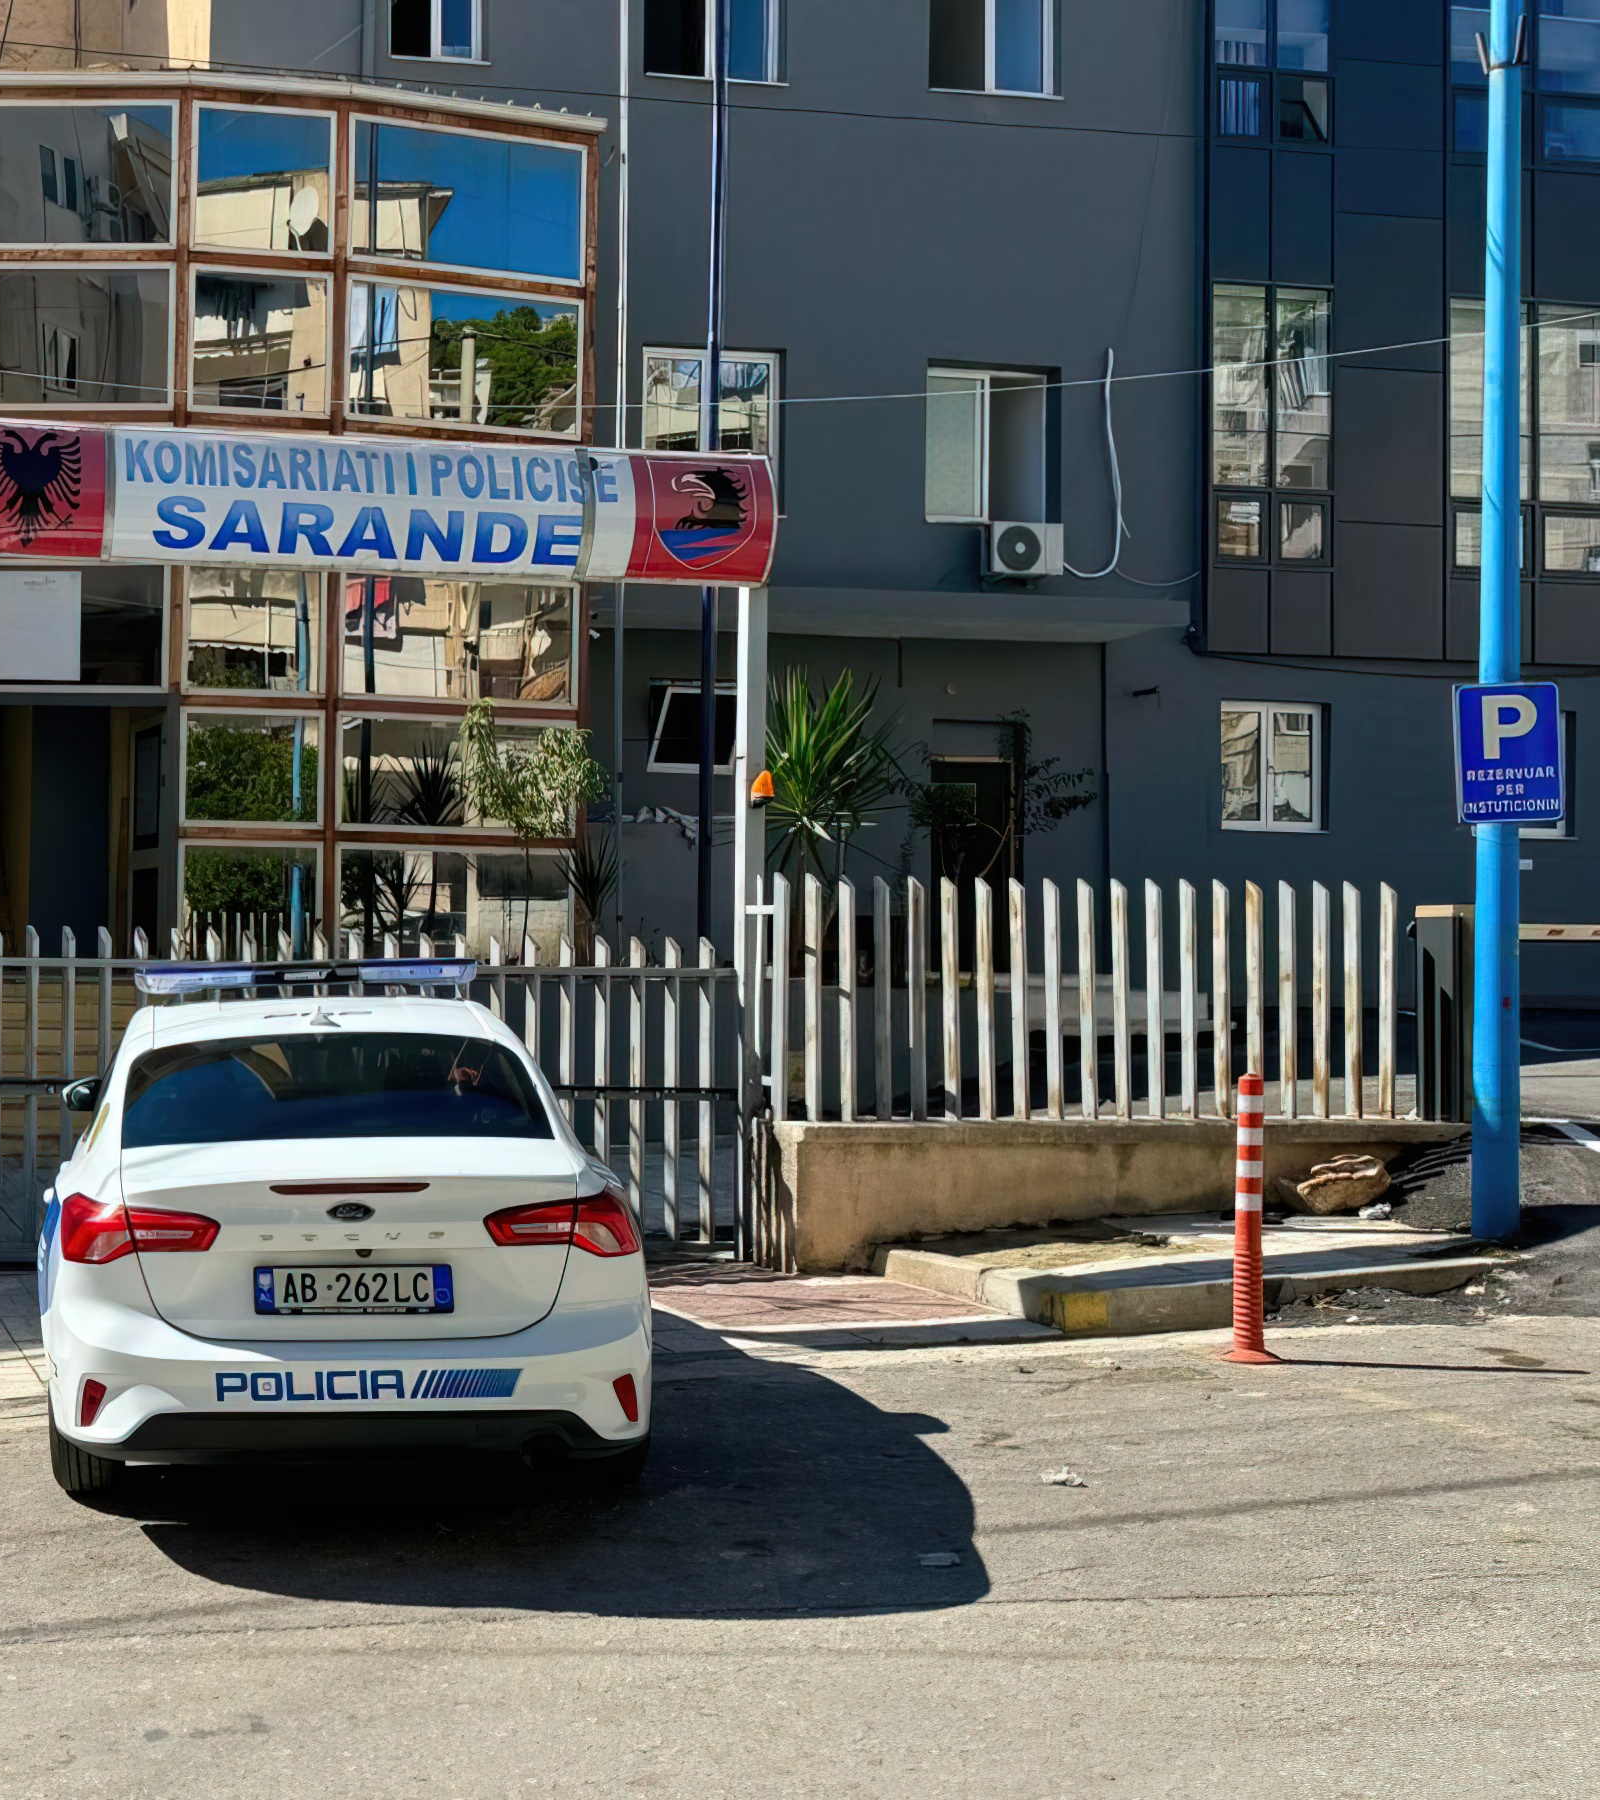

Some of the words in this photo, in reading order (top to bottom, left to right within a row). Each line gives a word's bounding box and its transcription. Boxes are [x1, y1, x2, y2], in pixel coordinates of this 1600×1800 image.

[124, 438, 396, 495] KOMISARIATI
[405, 451, 418, 496] I
[152, 495, 583, 566] SARANDE
[1481, 694, 1537, 759] P
[1466, 765, 1555, 781] REZERVUAR
[1495, 783, 1525, 796] PER
[283, 1272, 318, 1304] AB
[215, 1369, 406, 1402] POLICIA
